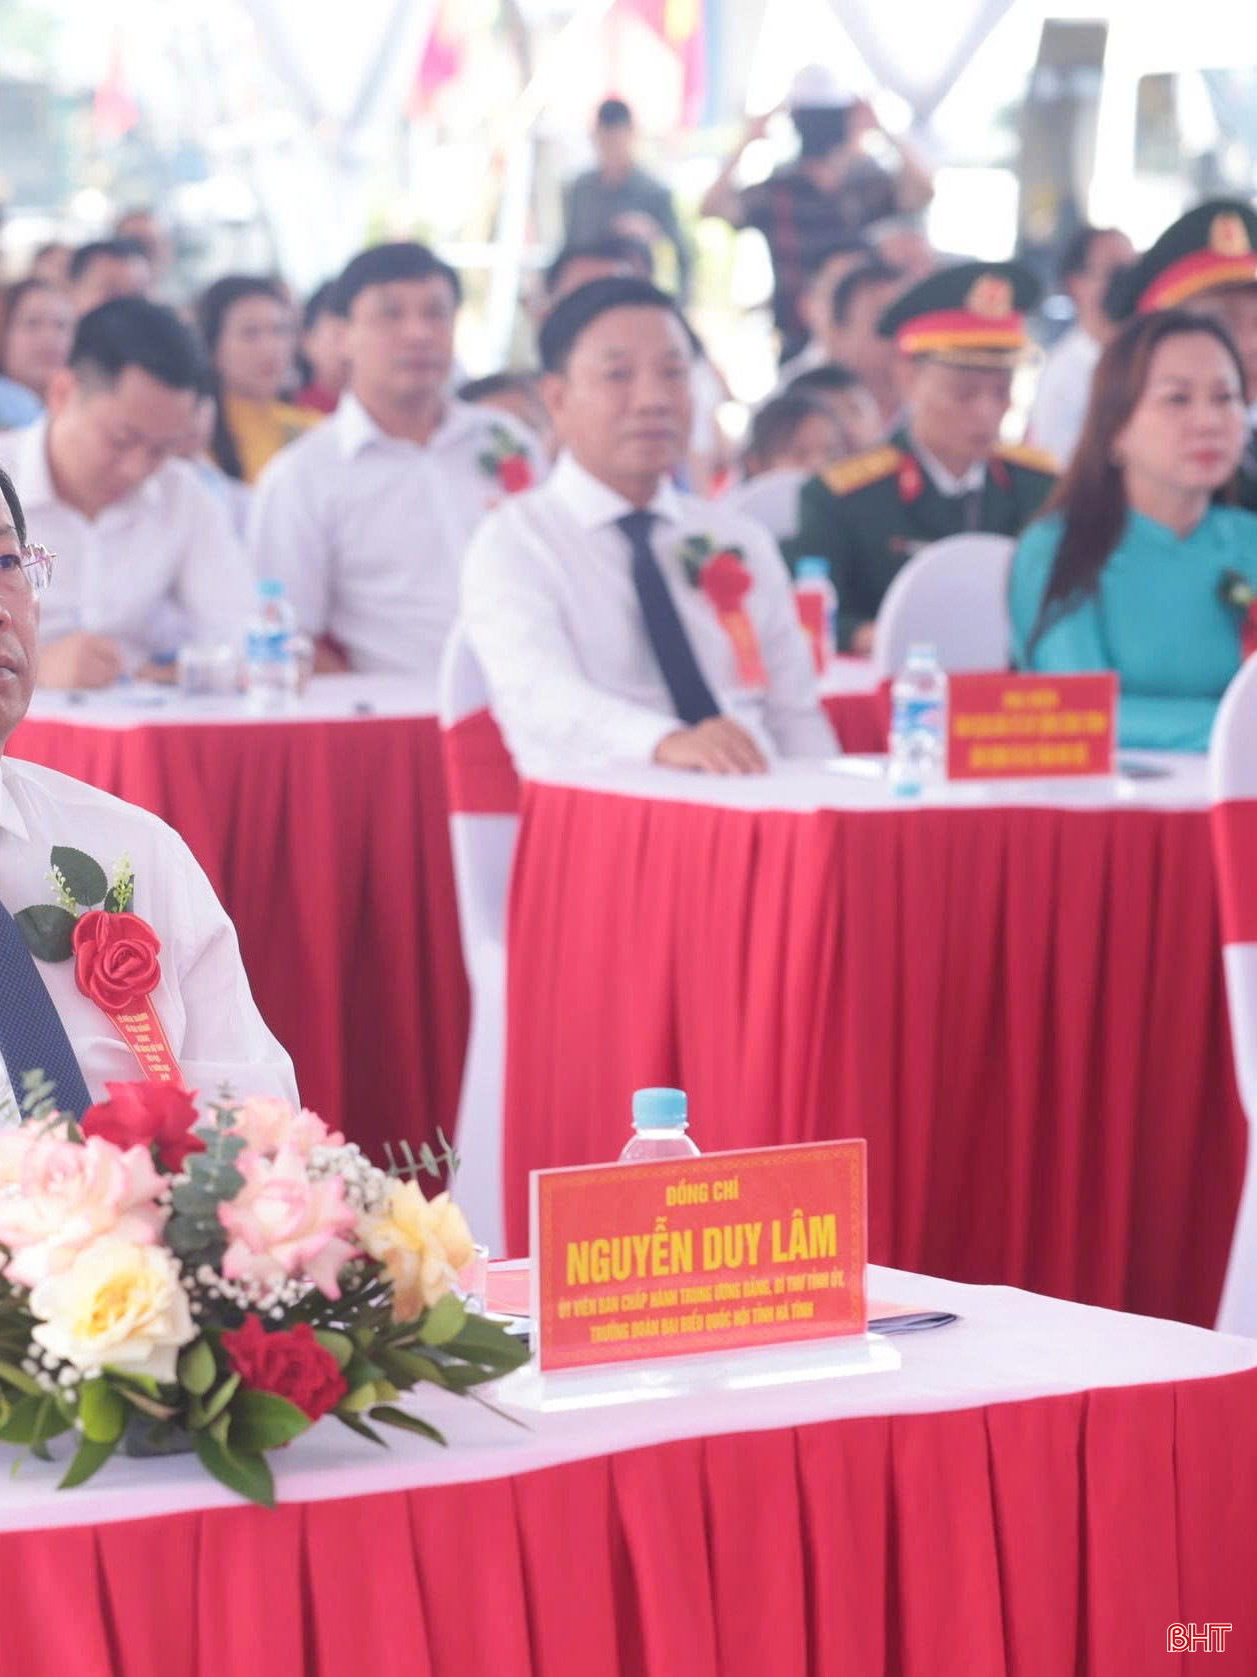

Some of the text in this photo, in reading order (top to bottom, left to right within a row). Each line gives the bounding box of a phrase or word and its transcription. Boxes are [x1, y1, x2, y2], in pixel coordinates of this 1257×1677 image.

[712, 1175, 740, 1201] CHÍ
[566, 1208, 838, 1286] NGUYỄN DUY LÂM
